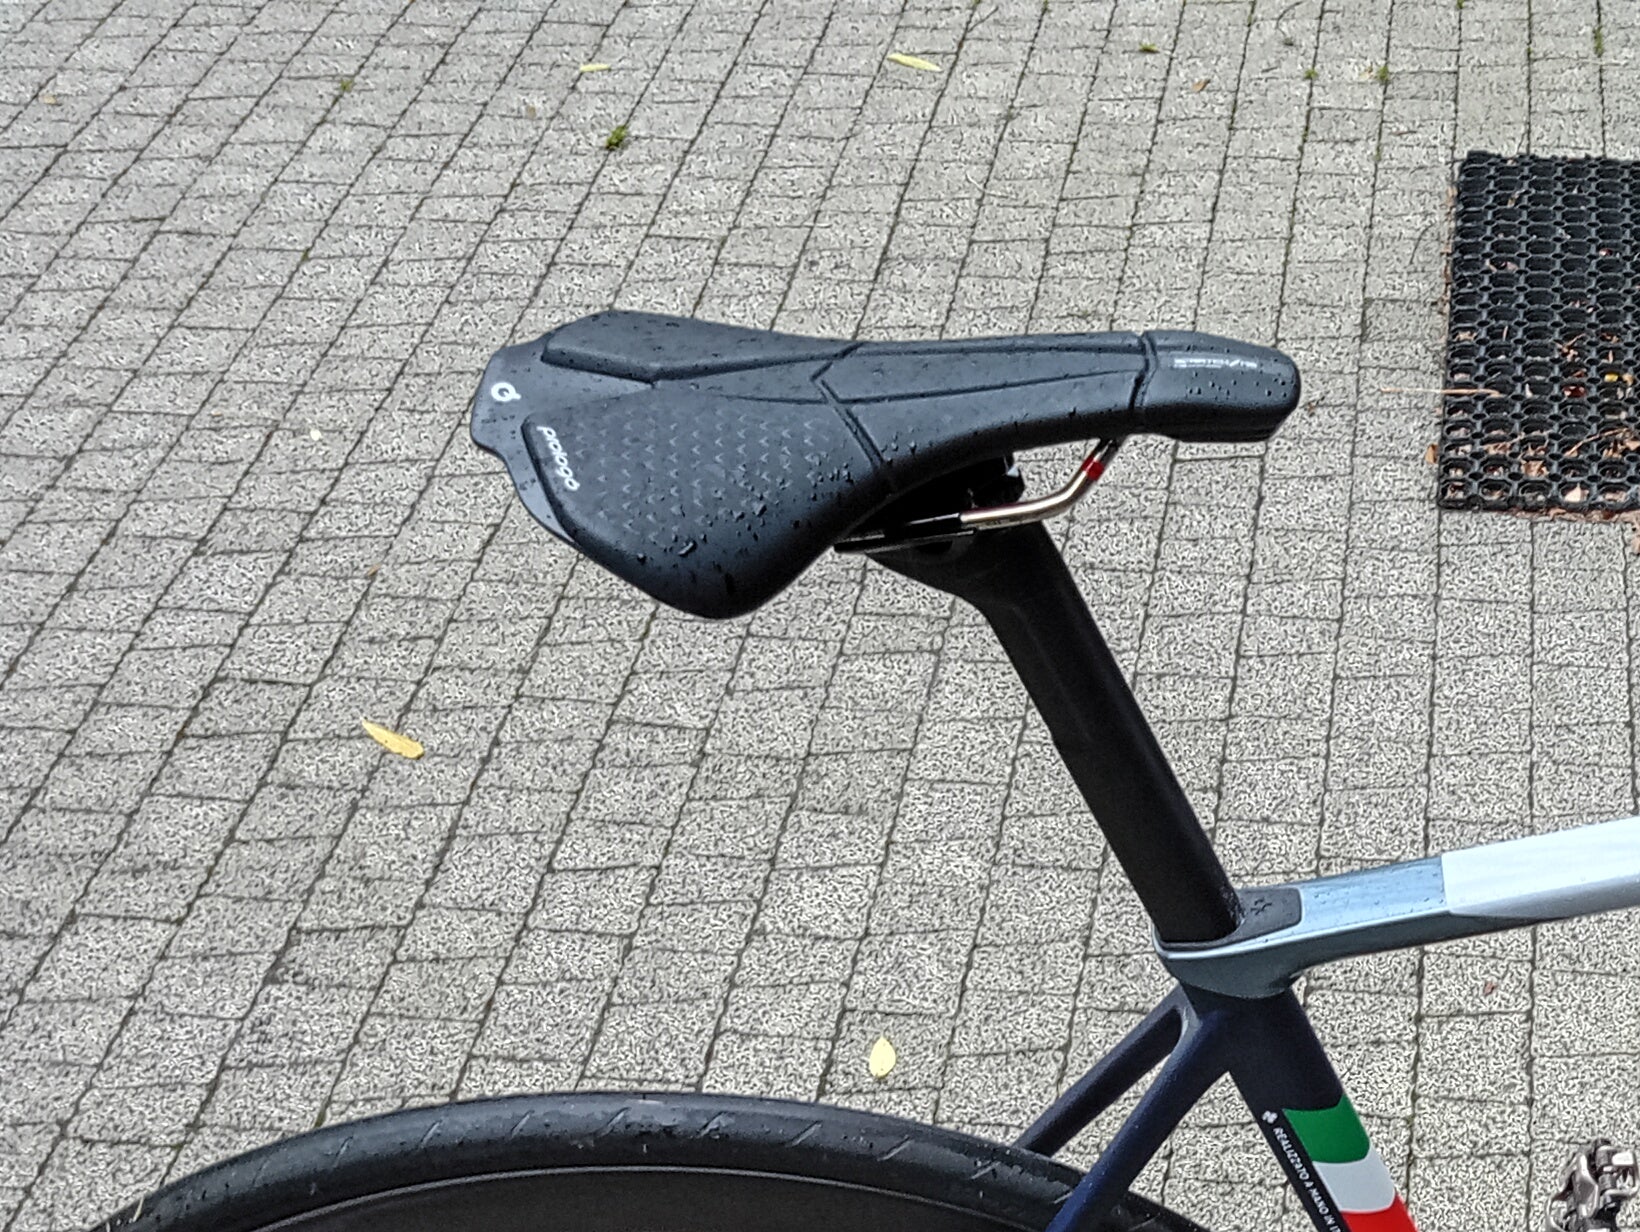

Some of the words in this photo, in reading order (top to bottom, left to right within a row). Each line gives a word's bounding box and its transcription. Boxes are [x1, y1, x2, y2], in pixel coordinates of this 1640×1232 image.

[536, 426, 580, 491] prologo
[1273, 1127, 1309, 1180] REALIZZATO
[1309, 1187, 1329, 1215] MANO
[1323, 1214, 1335, 1226] IN
